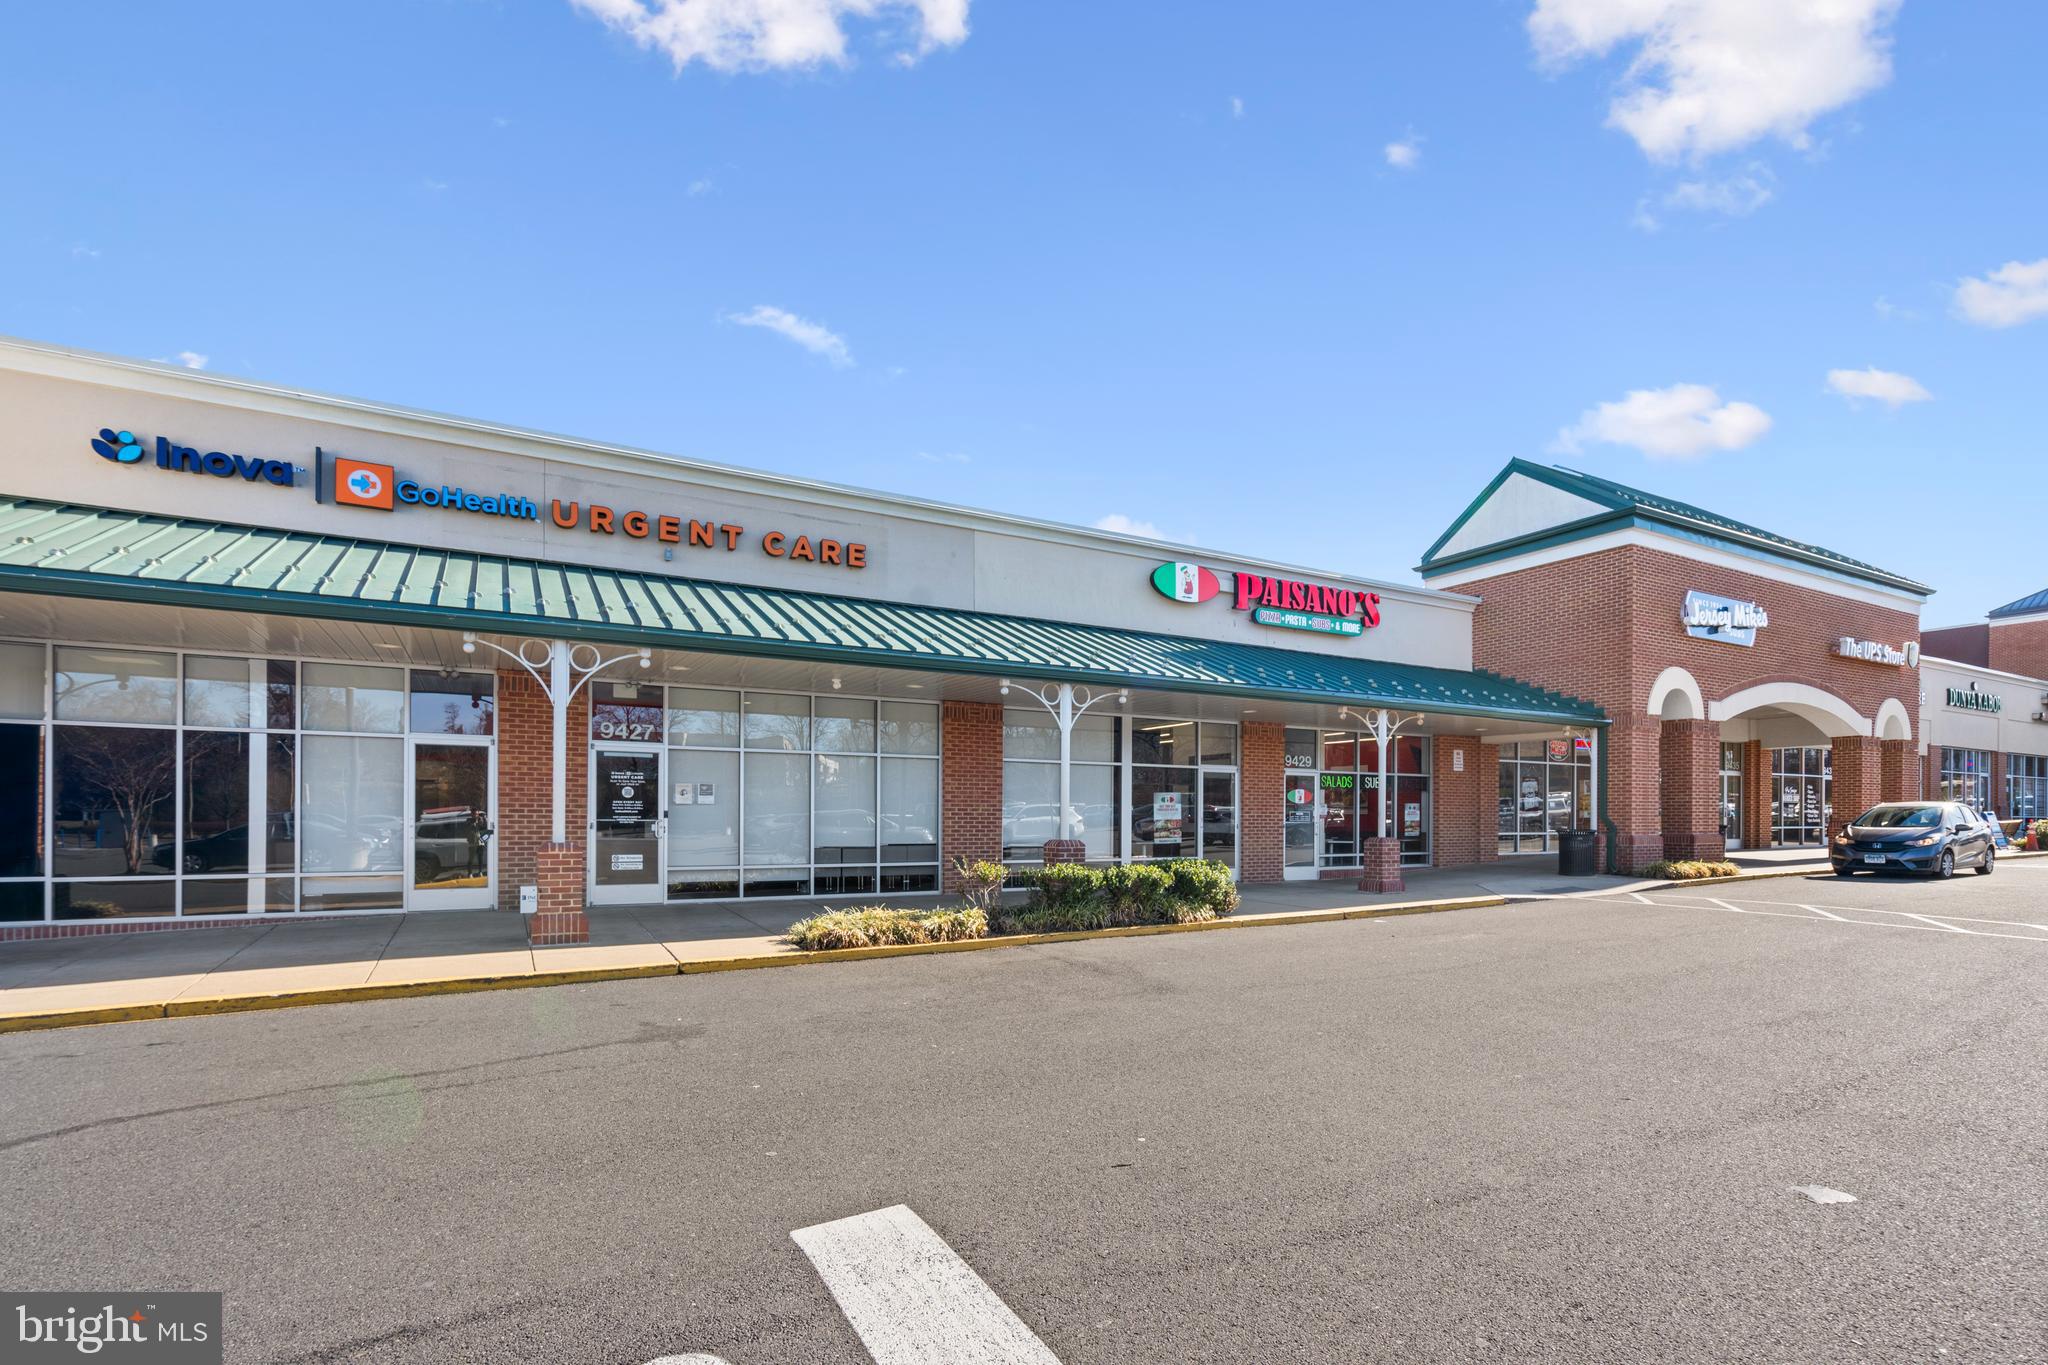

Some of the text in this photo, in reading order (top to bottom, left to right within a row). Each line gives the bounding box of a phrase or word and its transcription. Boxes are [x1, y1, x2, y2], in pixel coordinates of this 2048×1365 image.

[155, 435, 294, 487] Inova
[396, 479, 538, 521] GoHealth
[551, 498, 868, 568] URGENT CARE
[1233, 572, 1380, 628] PAISANO'S
[1260, 609, 1281, 624] PIZZA
[1284, 613, 1307, 627] PASTA
[1311, 617, 1331, 631] SUBS
[1342, 621, 1361, 634] MORE
[1688, 600, 1769, 632] Jersey Mike's
[1844, 637, 1905, 666] The UPS Store
[1949, 688, 1977, 709] DUNYA
[600, 722, 654, 740] 9427
[1285, 755, 1312, 767] 9429
[1321, 776, 1353, 788] SALADS
[1365, 777, 1380, 788] SUB
